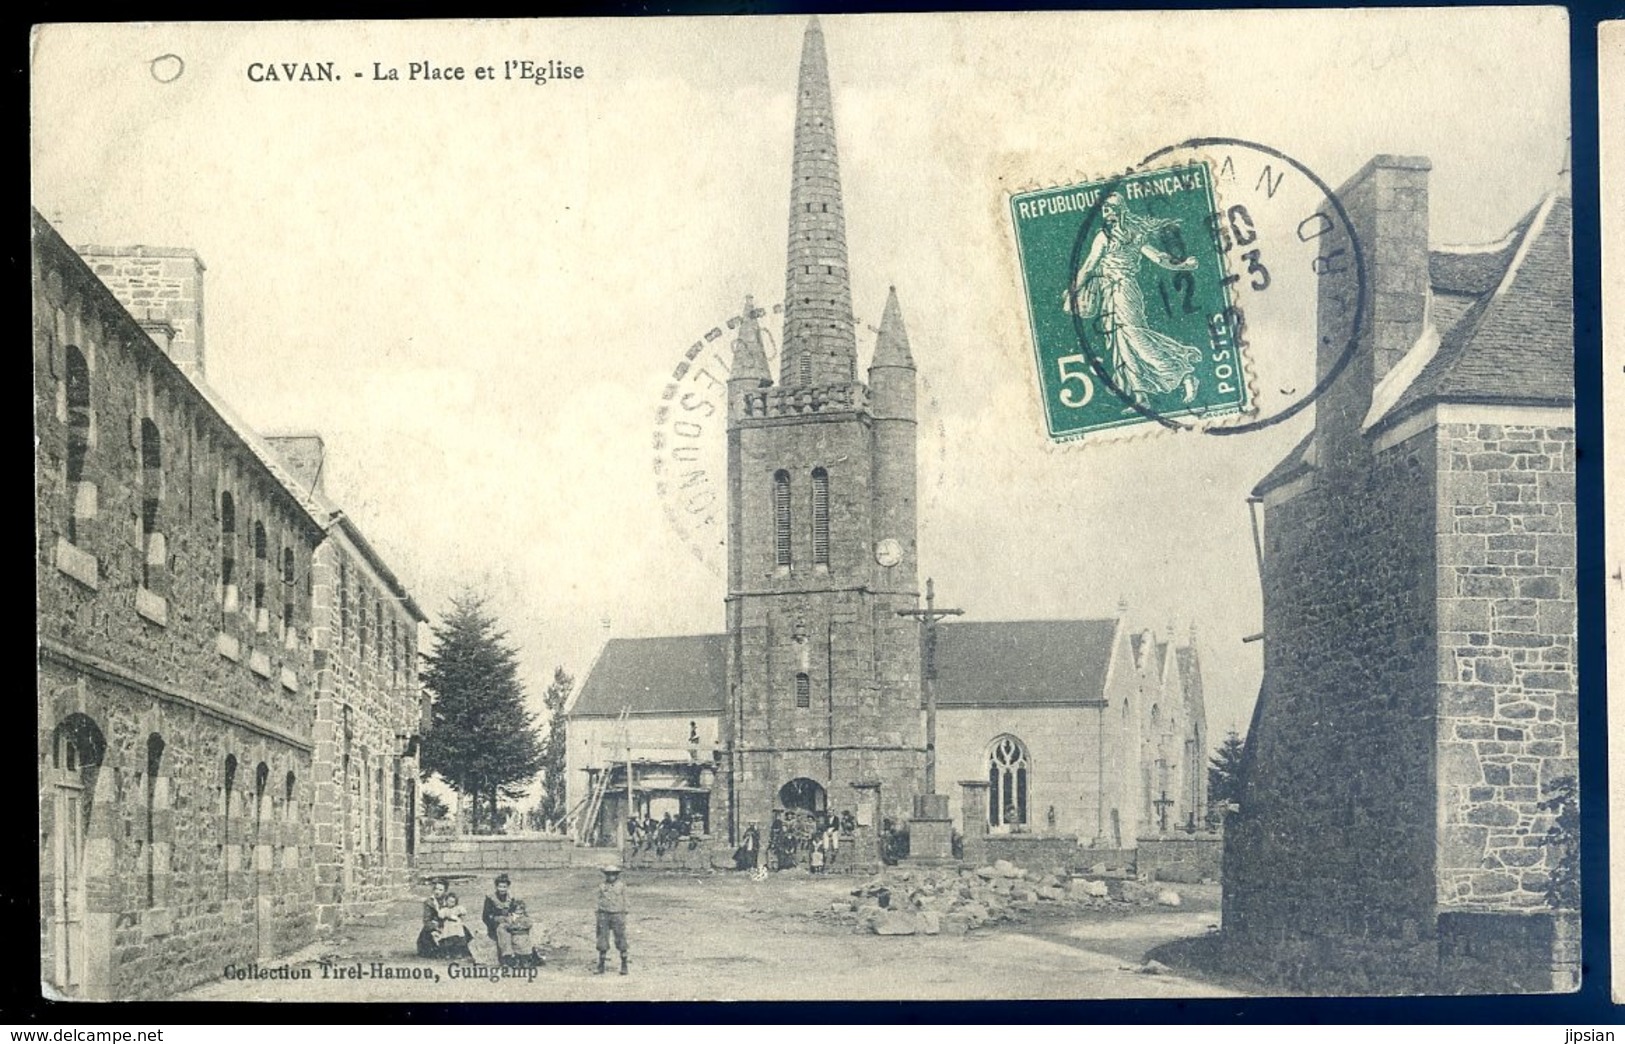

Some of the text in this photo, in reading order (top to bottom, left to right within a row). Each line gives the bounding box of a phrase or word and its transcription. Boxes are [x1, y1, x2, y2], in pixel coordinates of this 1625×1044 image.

[247, 62, 342, 82] CAVAN.
[373, 62, 400, 81] La
[408, 61, 466, 81] Place
[475, 65, 496, 80] et
[504, 60, 585, 85] l'Eglise
[223, 962, 312, 981] Collection
[447, 962, 539, 983] Guingamp
